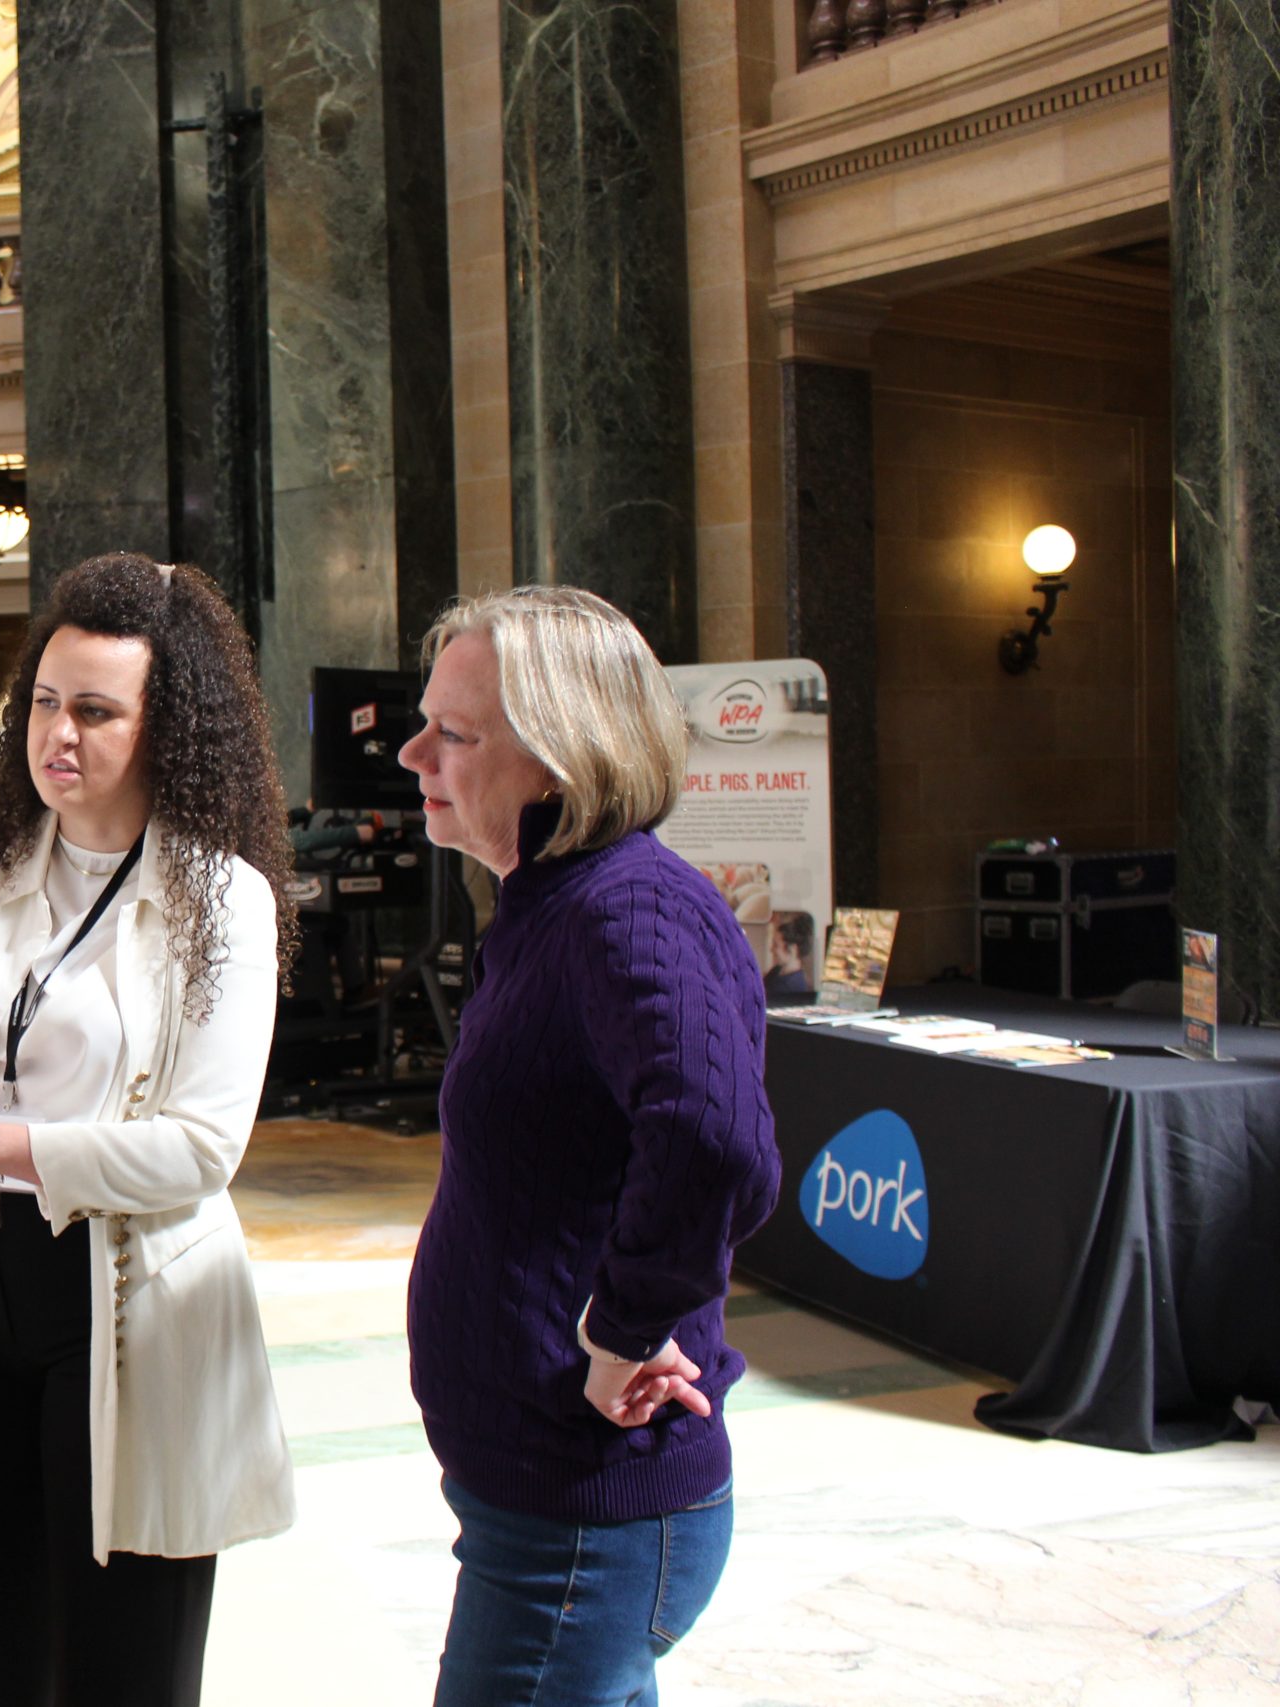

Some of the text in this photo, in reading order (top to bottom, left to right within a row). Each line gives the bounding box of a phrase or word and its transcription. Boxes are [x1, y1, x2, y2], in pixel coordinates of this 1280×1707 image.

[720, 704, 763, 727] WPA
[720, 773, 751, 791] PIGS.
[756, 772, 811, 791] PLANET.
[815, 1151, 924, 1241] pork
